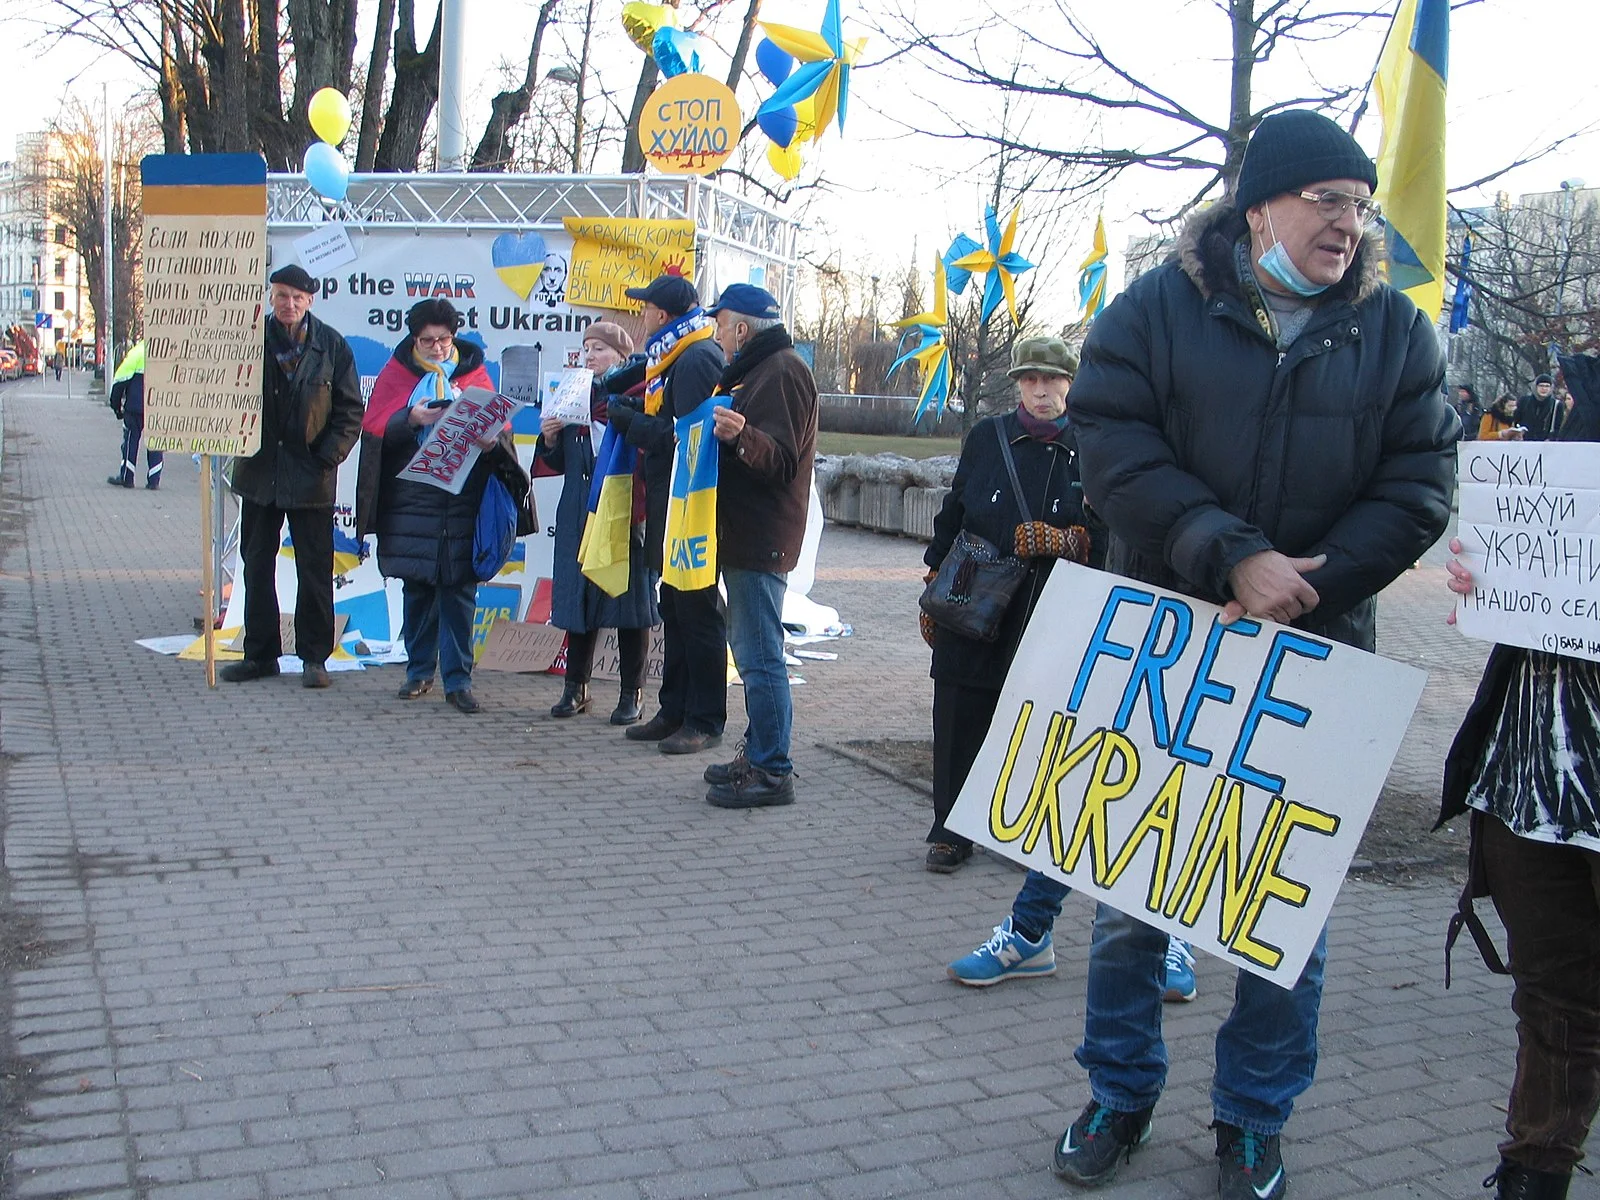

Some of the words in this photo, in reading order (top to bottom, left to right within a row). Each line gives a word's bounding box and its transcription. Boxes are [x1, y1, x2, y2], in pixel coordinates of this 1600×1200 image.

[658, 99, 720, 122] СТОП
[649, 123, 728, 153] ХУЙЛО
[149, 226, 188, 249] Если
[199, 230, 255, 249] можно
[146, 256, 238, 275] остановить
[249, 257, 259, 275] и
[572, 260, 592, 278] НЕ
[146, 279, 189, 304] убить
[348, 272, 394, 295] the
[404, 273, 476, 298] WAR
[569, 278, 612, 304] ВАША
[490, 306, 602, 332] Ukrain
[147, 387, 181, 407] Снос
[1470, 453, 1547, 489] СУКИ,
[1496, 491, 1576, 527] НАХУЙ
[1474, 586, 1551, 615] НАШОГО
[1561, 598, 1600, 621] СЕЛ
[1067, 585, 1333, 795] FREE
[989, 700, 1341, 971] UKRAINE
